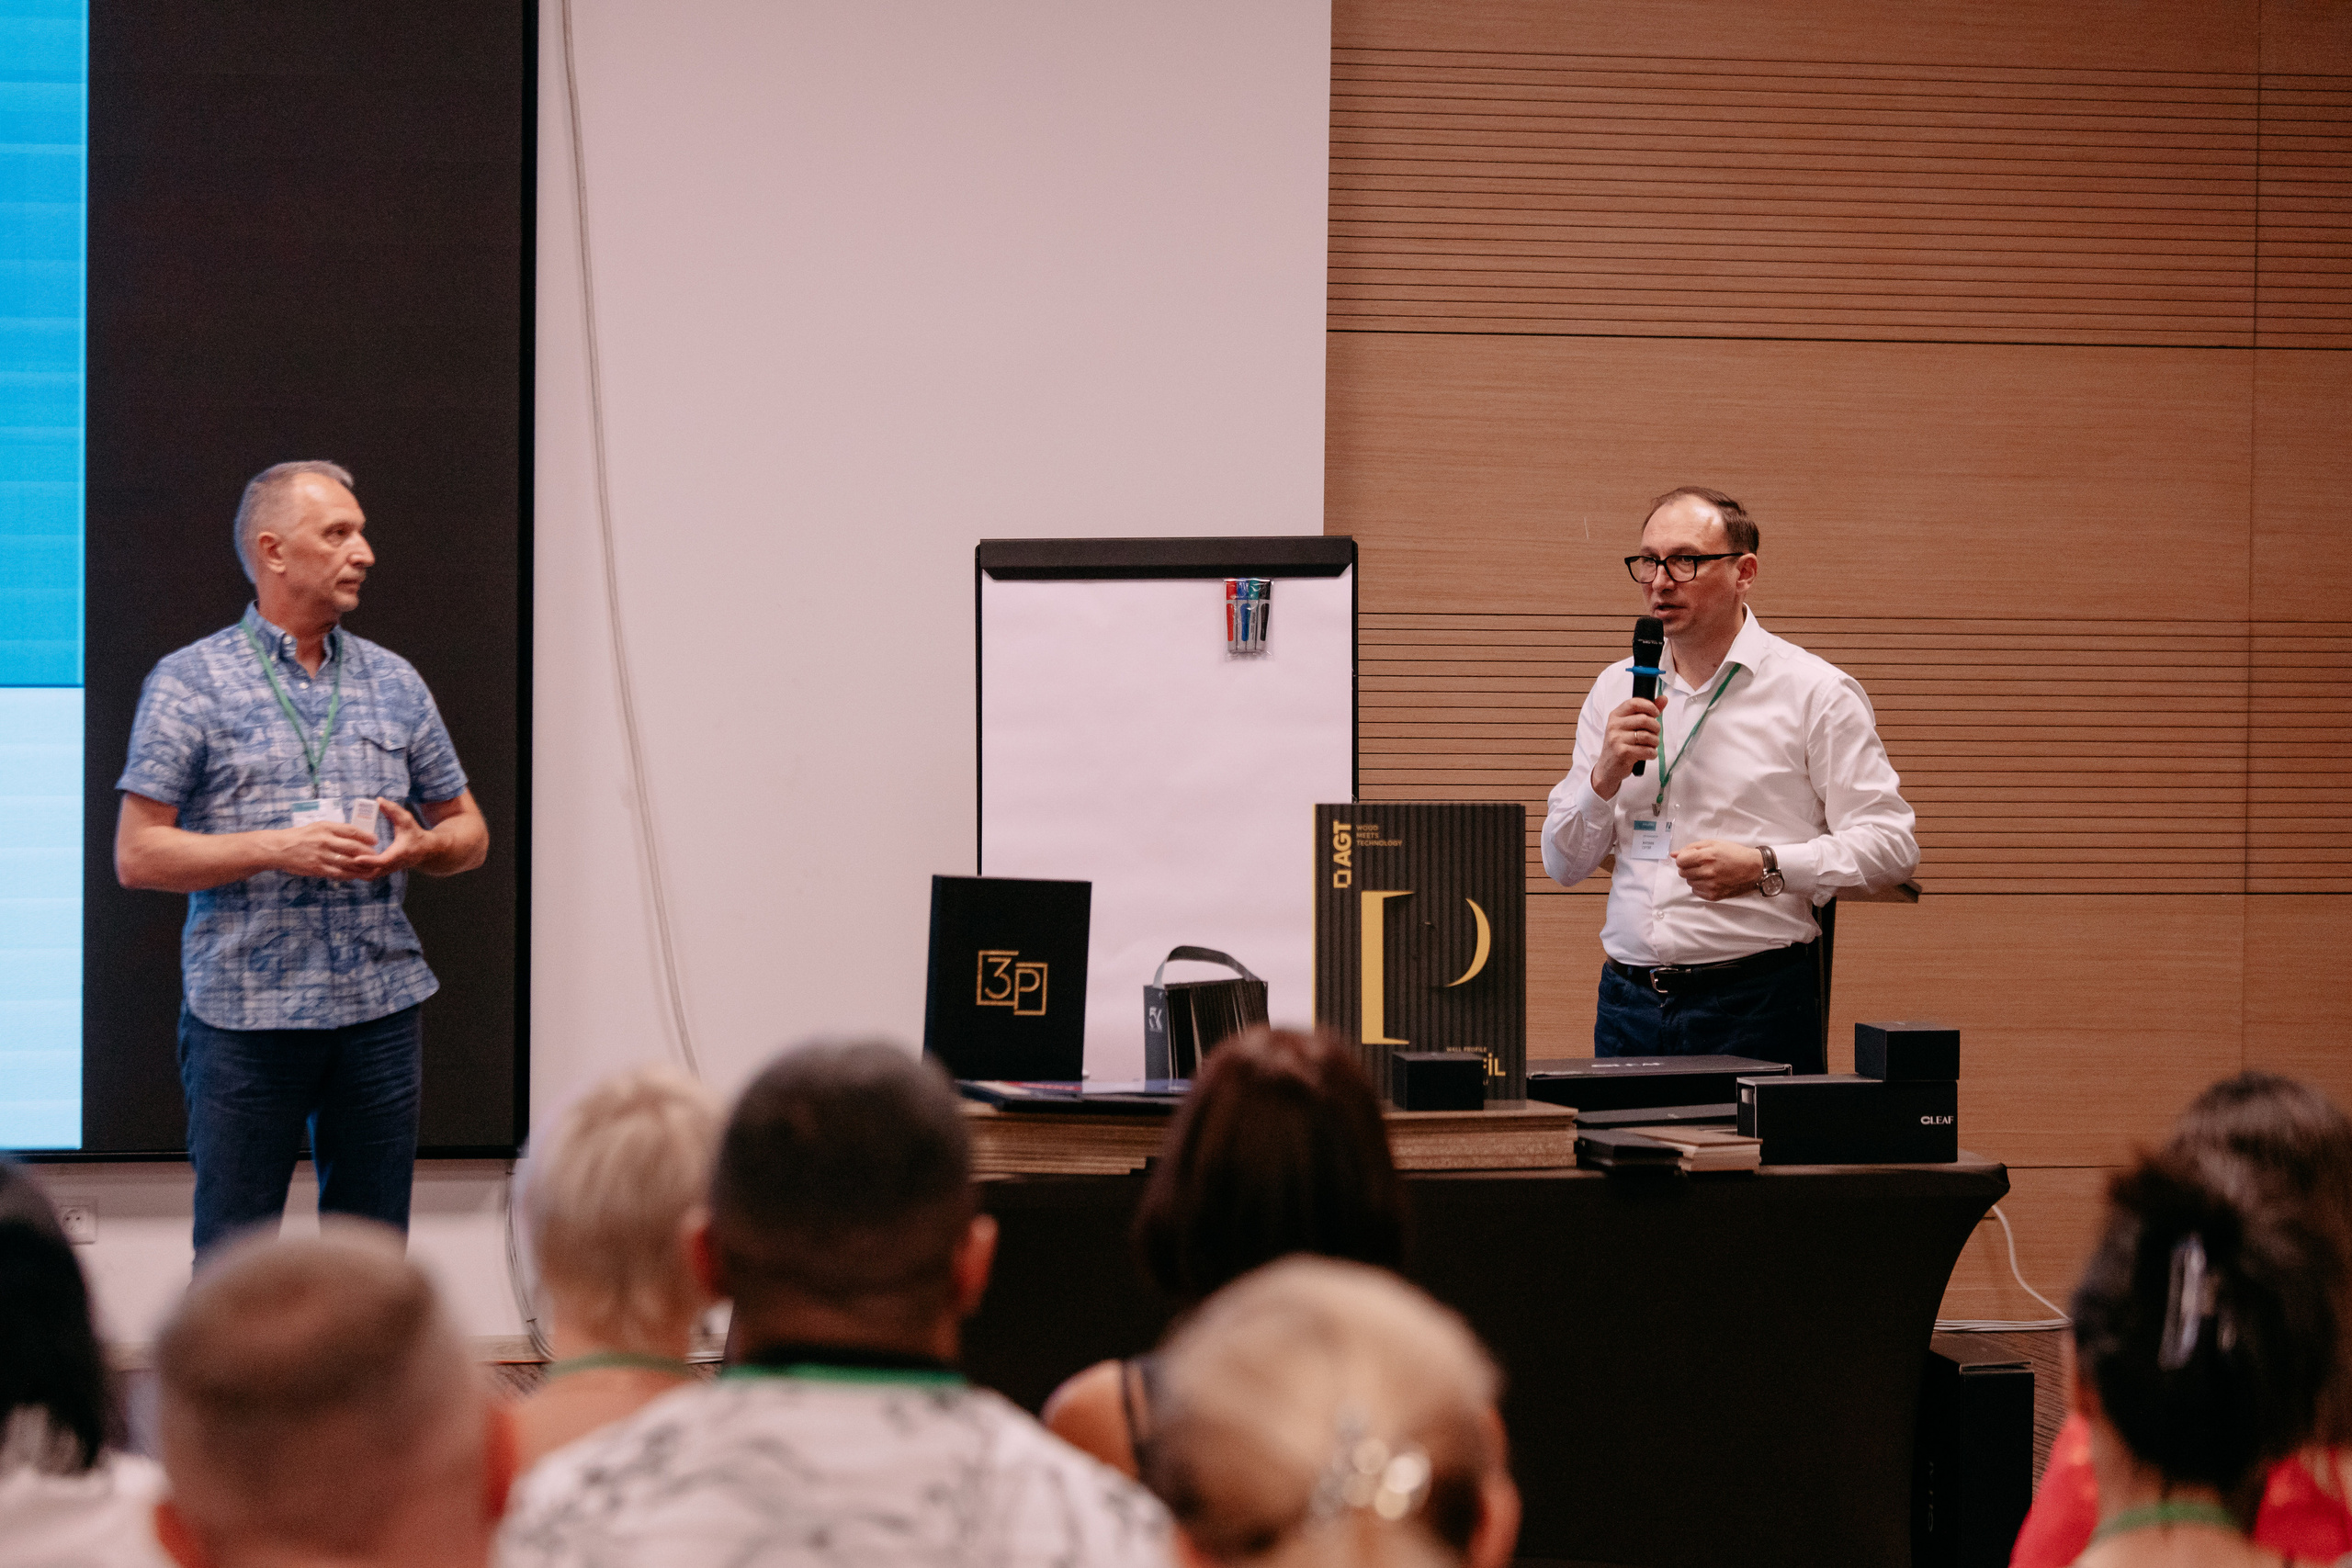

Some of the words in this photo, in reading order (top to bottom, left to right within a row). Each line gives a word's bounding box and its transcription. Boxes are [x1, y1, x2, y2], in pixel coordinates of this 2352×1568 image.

[1333, 820, 1351, 867] AGT
[983, 956, 1042, 1011] 3P
[1920, 1115, 1955, 1125] CLEAF
